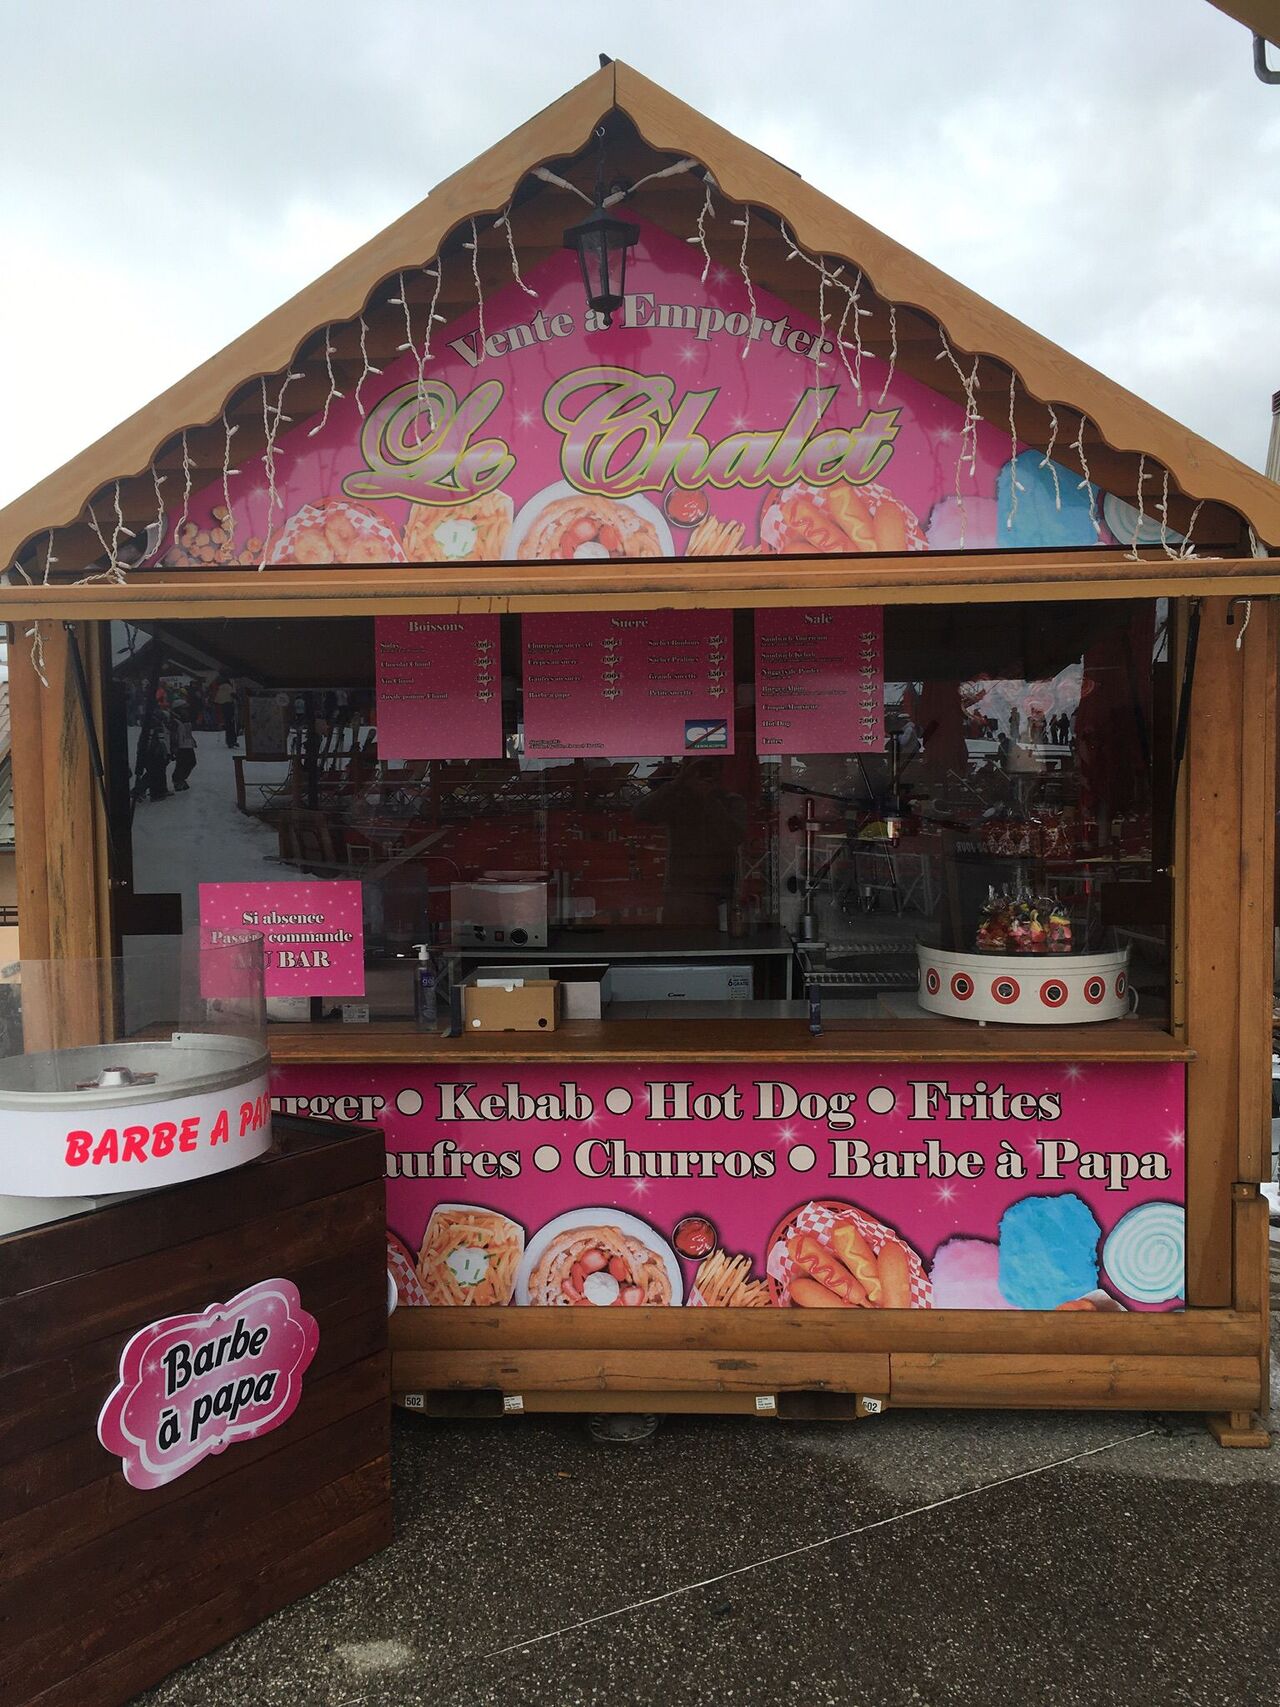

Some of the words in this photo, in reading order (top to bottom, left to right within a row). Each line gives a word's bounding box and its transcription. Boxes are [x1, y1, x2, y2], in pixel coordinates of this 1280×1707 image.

[447, 308, 575, 368] Vente
[620, 293, 837, 367] Emporter
[341, 378, 517, 506] Le
[543, 365, 904, 499] Chalet
[408, 621, 464, 632] Boissons
[610, 616, 649, 629] Sucré
[804, 612, 833, 624] Salé
[242, 910, 259, 925] Si
[262, 910, 325, 925] absence
[268, 929, 353, 943] commande
[277, 951, 330, 968] BAR
[435, 1082, 595, 1122] Kebab
[644, 1081, 743, 1121] Hot
[753, 1080, 857, 1129] Dog
[907, 1080, 1061, 1121] Frites
[65, 1116, 201, 1167] BARBE
[209, 1109, 229, 1147] A
[382, 1139, 521, 1178] aufres
[573, 1139, 775, 1178] Churros
[828, 1139, 985, 1179] Barbe
[995, 1142, 1026, 1178] à
[1037, 1139, 1171, 1191] Papa
[163, 1318, 269, 1396] Barbe
[190, 1371, 278, 1442] papa
[406, 1397, 422, 1407] 502
